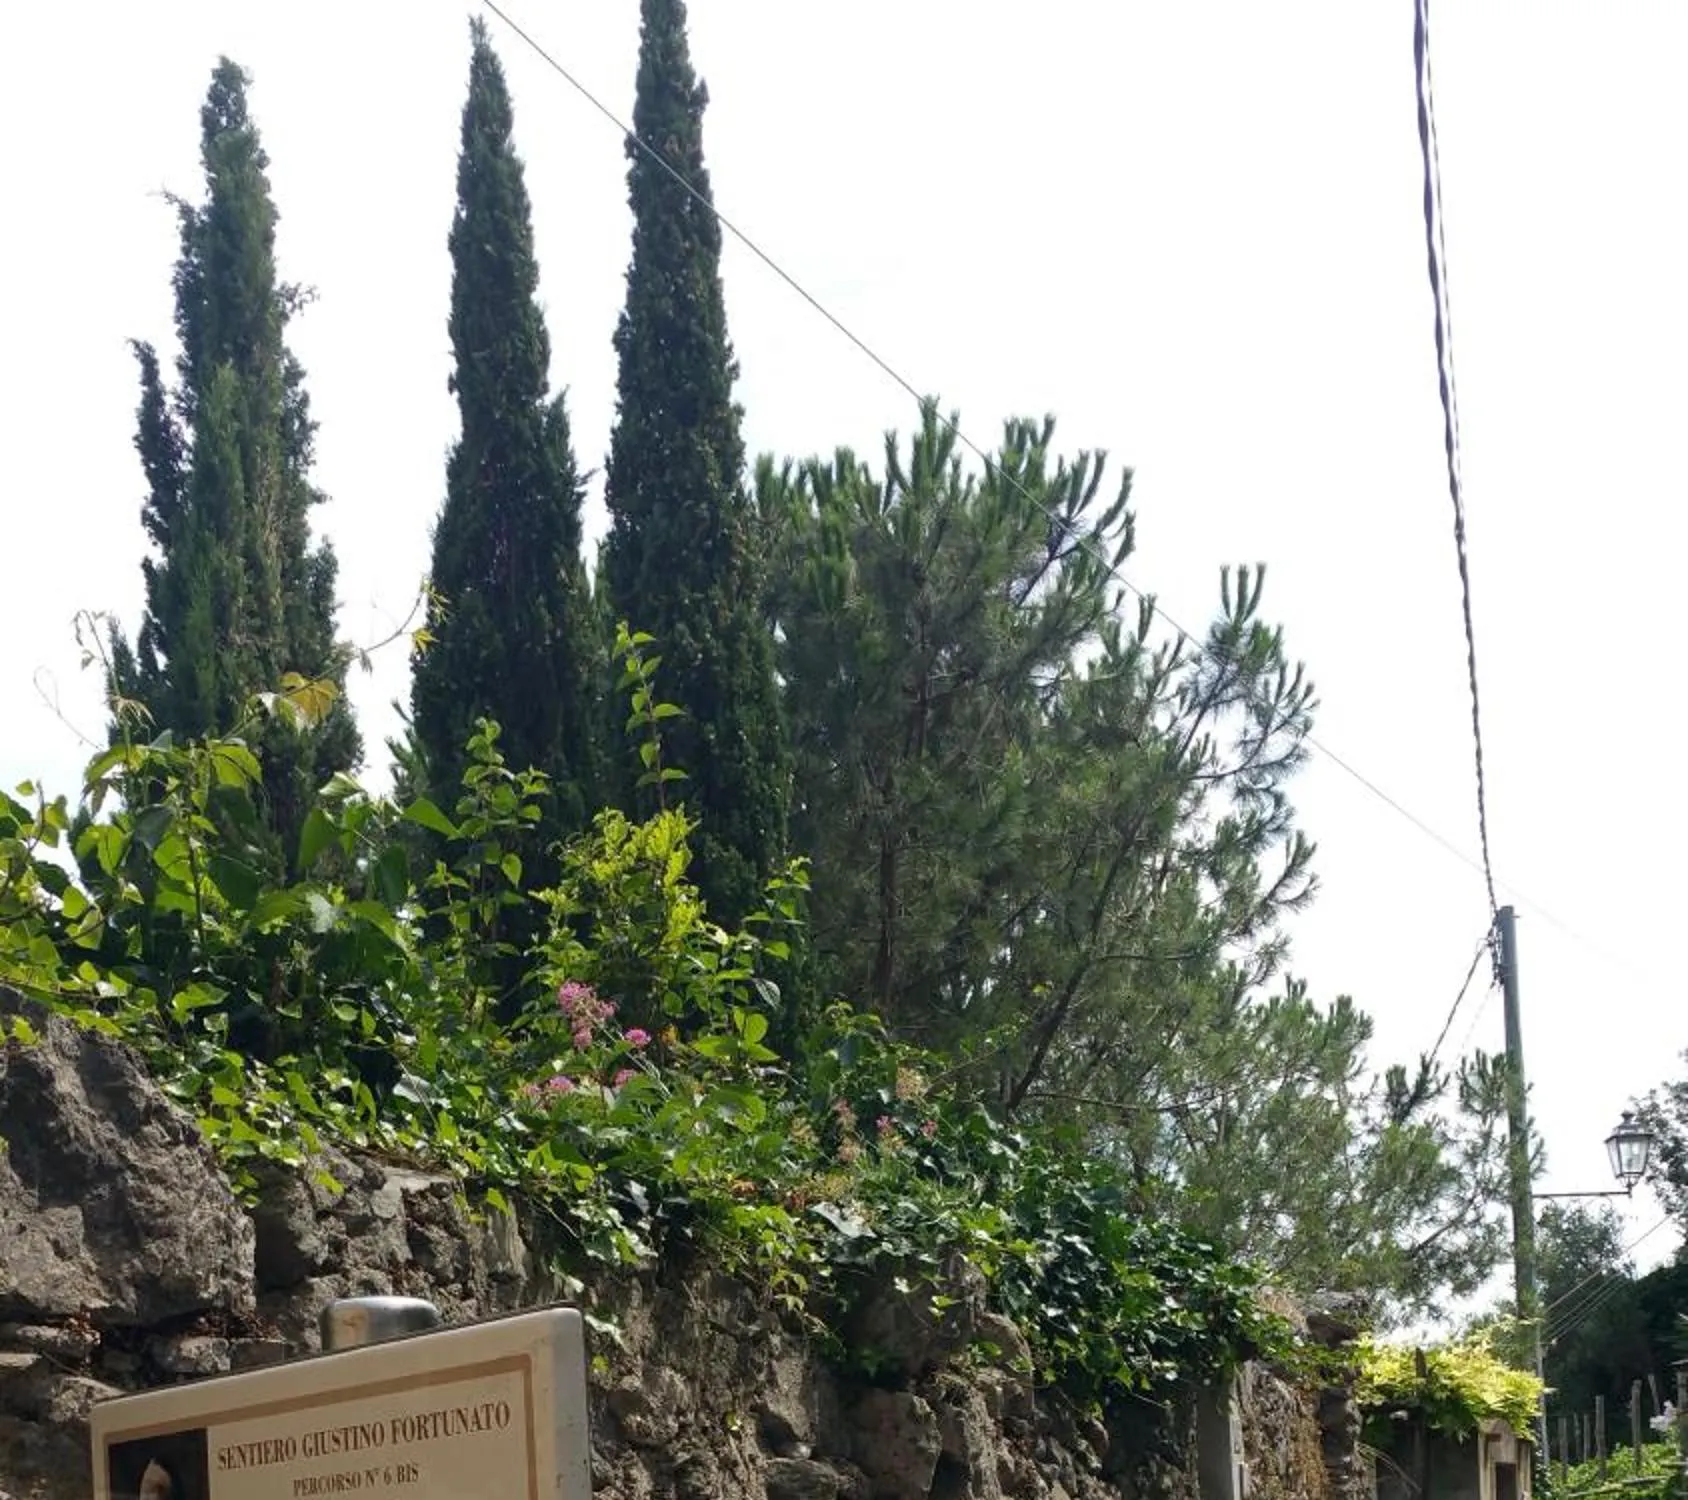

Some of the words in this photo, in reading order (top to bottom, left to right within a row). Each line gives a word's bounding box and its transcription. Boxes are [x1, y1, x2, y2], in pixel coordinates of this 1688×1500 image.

[217, 1436, 297, 1471] SENTIERO
[301, 1421, 386, 1459] GIUSTINO
[391, 1400, 512, 1445] FORTUNATO
[293, 1471, 361, 1497] PERCORSO
[384, 1465, 393, 1486] 6
[397, 1462, 419, 1485] BIS
